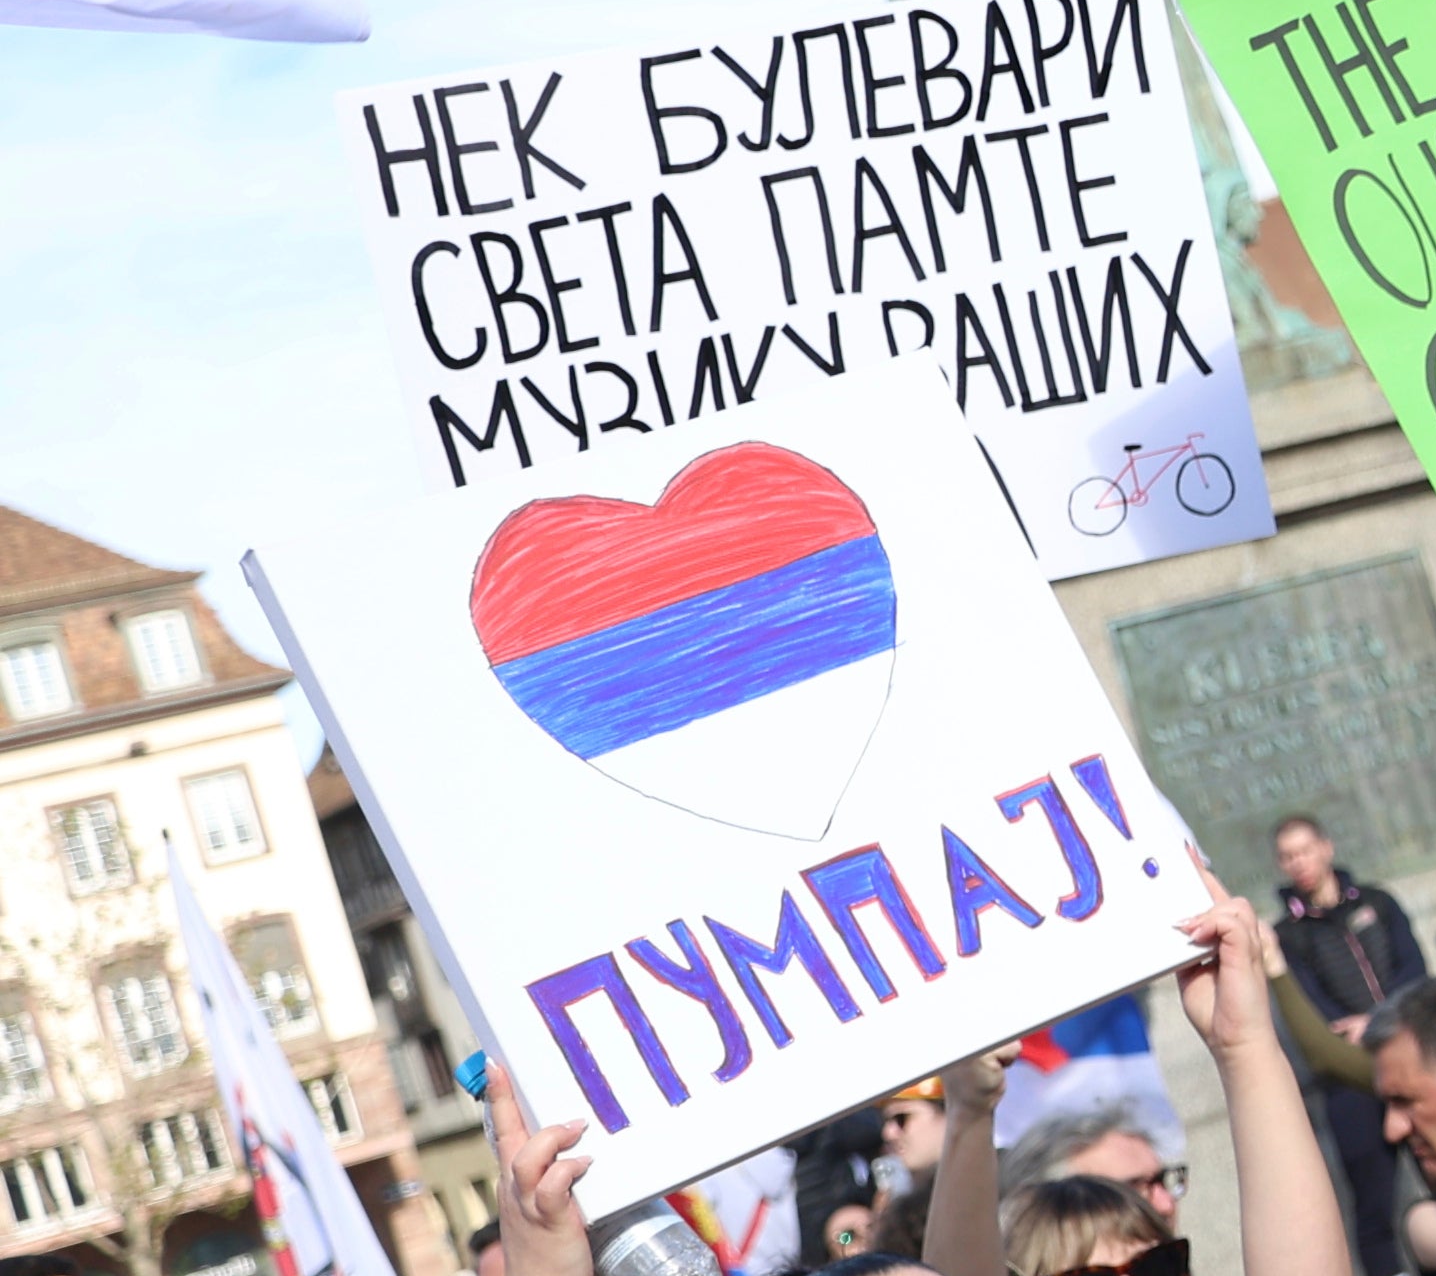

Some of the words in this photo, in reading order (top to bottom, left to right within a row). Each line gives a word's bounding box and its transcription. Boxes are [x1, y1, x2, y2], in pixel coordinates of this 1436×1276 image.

[363, 72, 586, 217] НЕК
[411, 193, 720, 370] СВЕТА
[760, 112, 1128, 305] ПАМТЕ
[524, 754, 1161, 1134] ПУМПАЈ!
